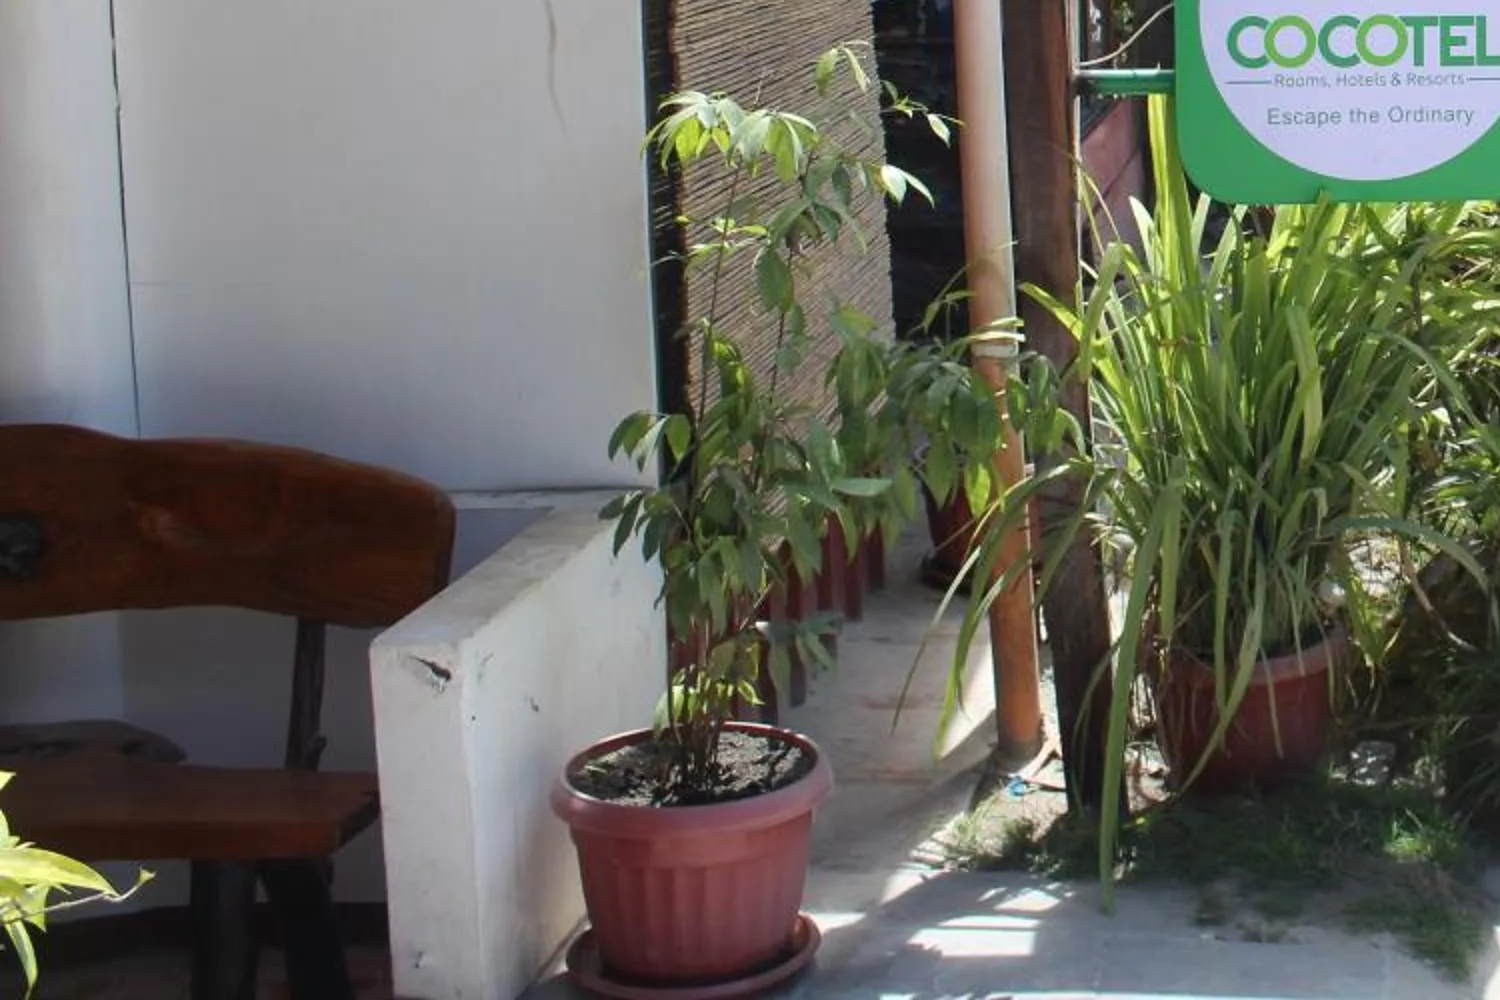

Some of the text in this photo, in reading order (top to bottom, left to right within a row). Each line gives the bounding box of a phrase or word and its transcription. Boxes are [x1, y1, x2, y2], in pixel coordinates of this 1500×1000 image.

[1275, 71, 1465, 88] Rooms, Hotels & Resorts
[1267, 106, 1475, 126] Escape the Ordinary
